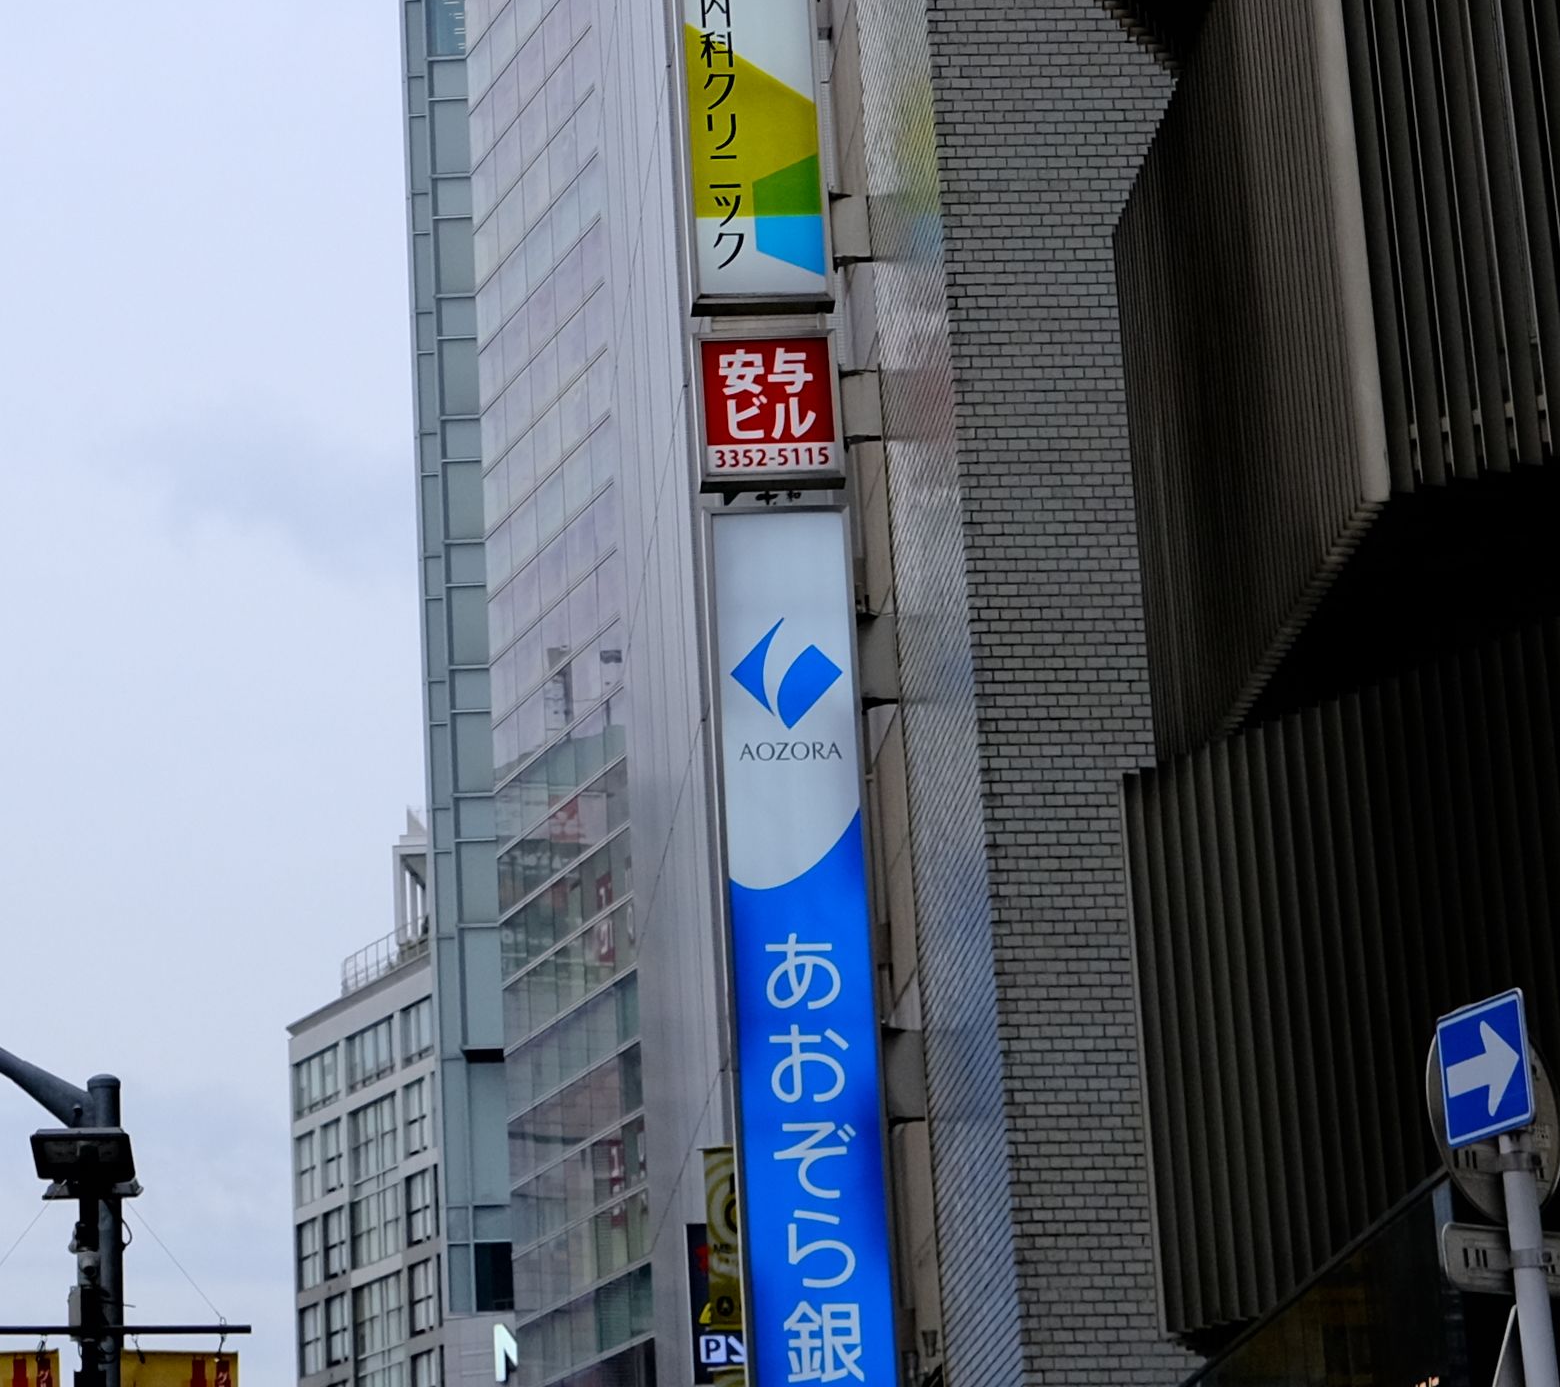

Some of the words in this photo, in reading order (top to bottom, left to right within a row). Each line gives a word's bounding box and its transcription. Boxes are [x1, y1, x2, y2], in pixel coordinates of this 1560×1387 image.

[718, 346, 814, 395] 安与
[726, 396, 818, 441] ビル
[713, 445, 831, 470] 3352-5115
[738, 741, 843, 763] AOZORA
[763, 933, 867, 1385] あおぞら銀
